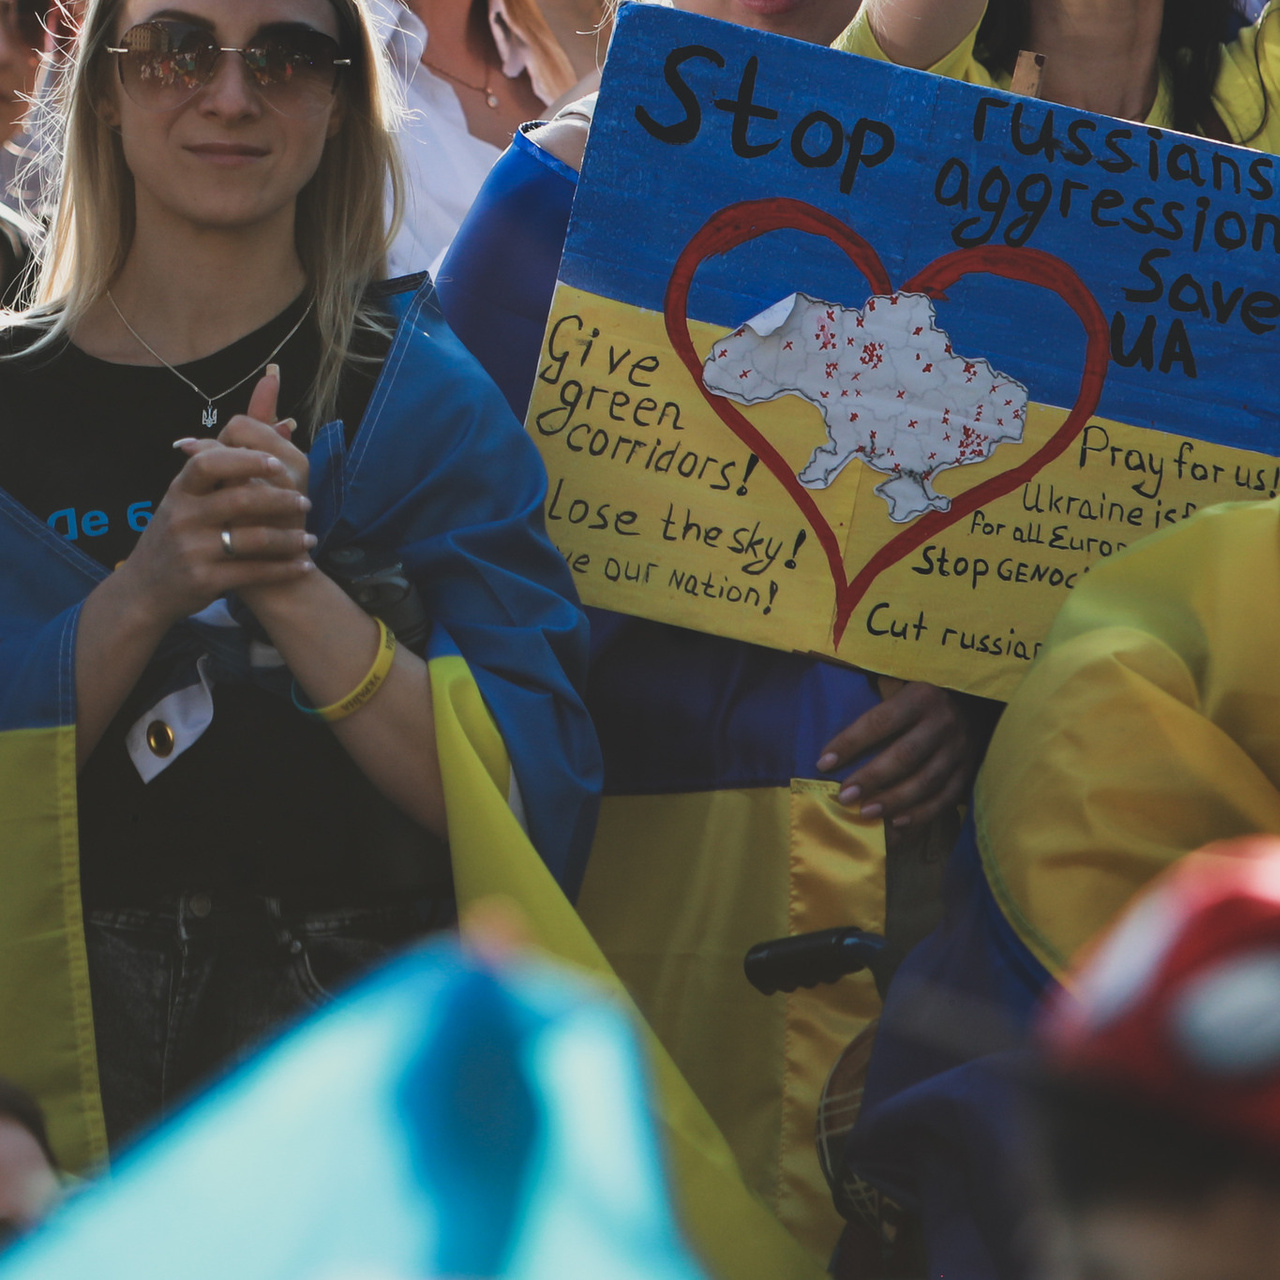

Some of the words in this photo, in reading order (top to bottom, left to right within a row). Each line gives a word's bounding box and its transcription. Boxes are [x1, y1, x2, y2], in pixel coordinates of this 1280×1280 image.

[634, 44, 895, 195] Stop
[973, 97, 1273, 201] russians
[934, 158, 1280, 251] aggression
[1121, 248, 1280, 335] Save
[538, 314, 660, 387] Give
[1110, 311, 1197, 379] UA
[536, 380, 685, 435] green
[566, 423, 759, 496] corridors!
[1080, 425, 1165, 499] Pray
[1173, 442, 1225, 483] for
[661, 503, 722, 548] the
[1023, 483, 1144, 526] Ukraine
[605, 557, 659, 584] our
[911, 545, 989, 590] Stop
[996, 558, 1090, 590] GENOC
[1048, 525, 1127, 558] Euro
[866, 602, 928, 642] Cut
